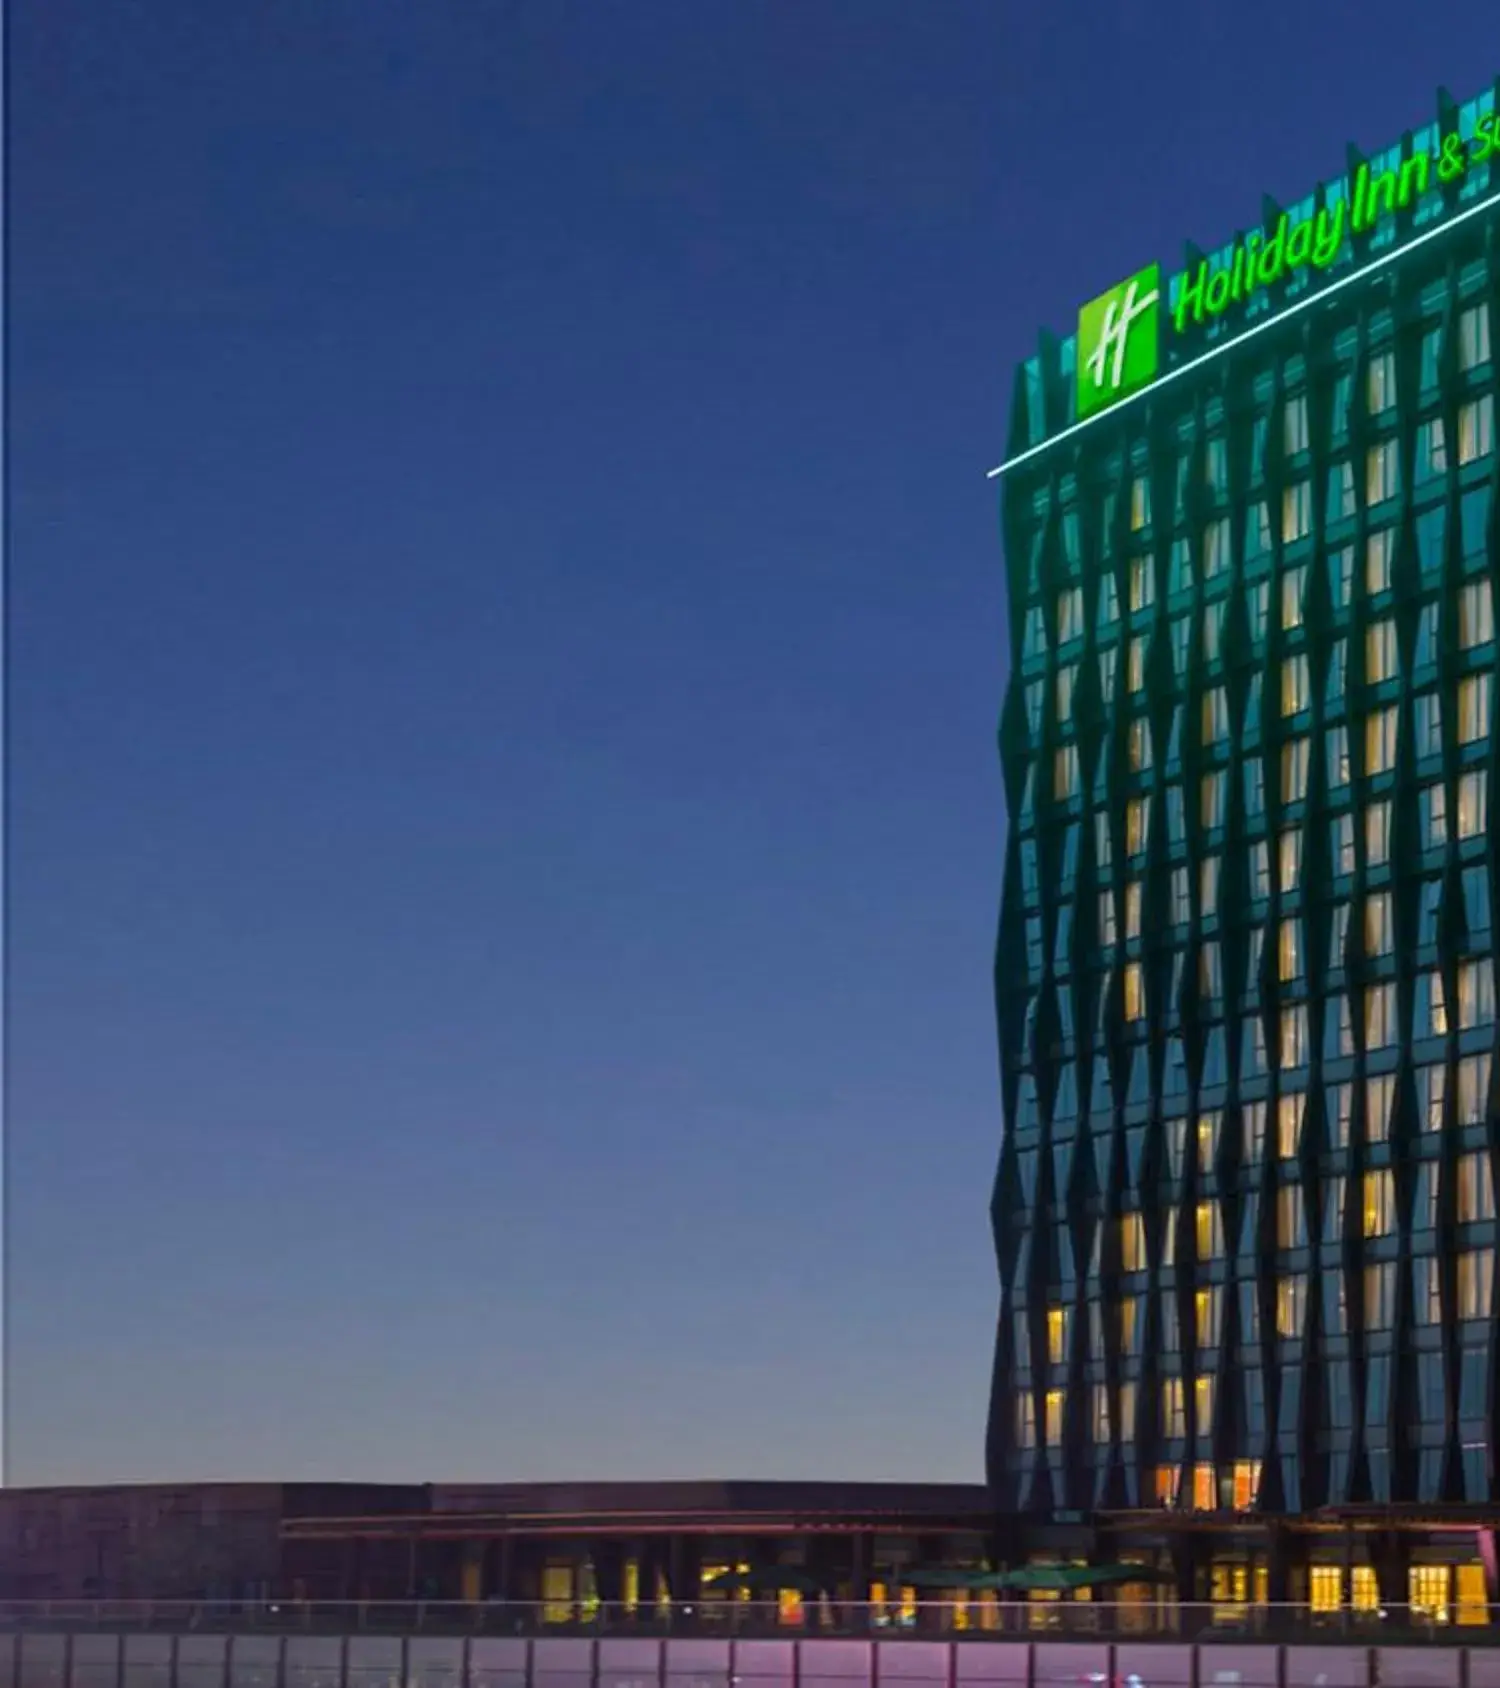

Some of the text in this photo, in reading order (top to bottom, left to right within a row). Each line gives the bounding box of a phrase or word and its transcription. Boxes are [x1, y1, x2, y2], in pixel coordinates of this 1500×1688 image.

[1172, 197, 1346, 332] Holiday
[1350, 162, 1430, 232] Inn
[1437, 132, 1465, 182] &
[1086, 281, 1160, 388] H
